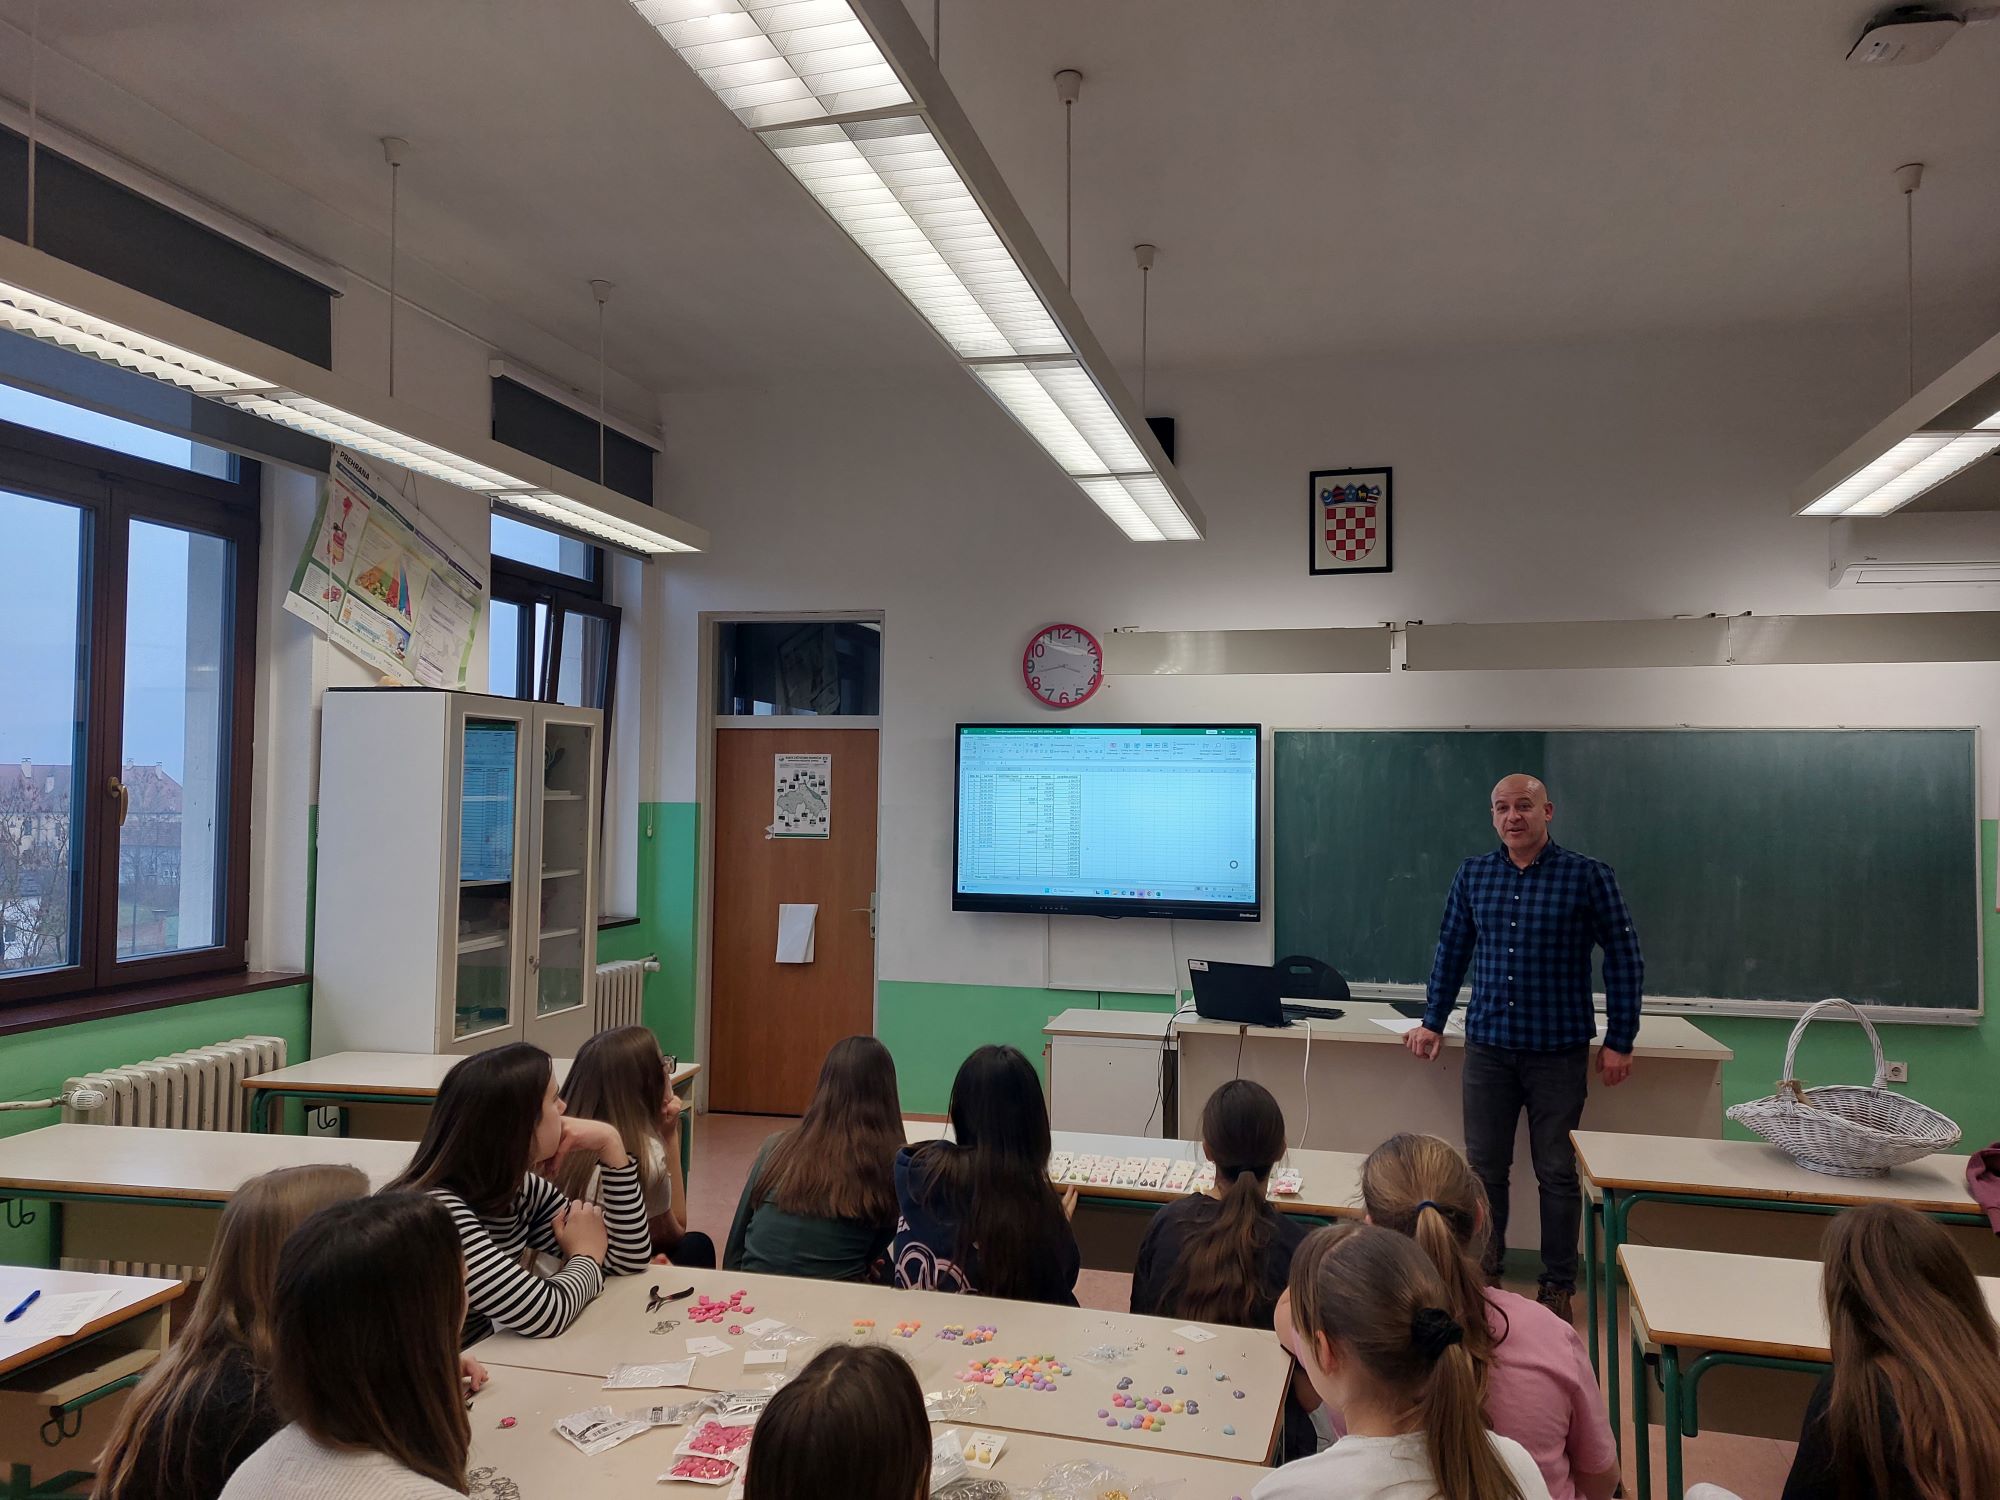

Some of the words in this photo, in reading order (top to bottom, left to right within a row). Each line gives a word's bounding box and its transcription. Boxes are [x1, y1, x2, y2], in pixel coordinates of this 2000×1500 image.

[340, 451, 370, 481] PREHRANA
[1057, 628, 1072, 639] 12
[1075, 632, 1081, 643] 1
[1031, 644, 1045, 658] 10
[1087, 641, 1097, 655] 2
[1027, 660, 1035, 673] 9
[1092, 659, 1100, 673] 3
[1031, 677, 1041, 690] 8
[1087, 674, 1096, 686] 4
[1044, 688, 1055, 700] 7
[1059, 691, 1070, 704] 6
[1075, 688, 1084, 701] 5
